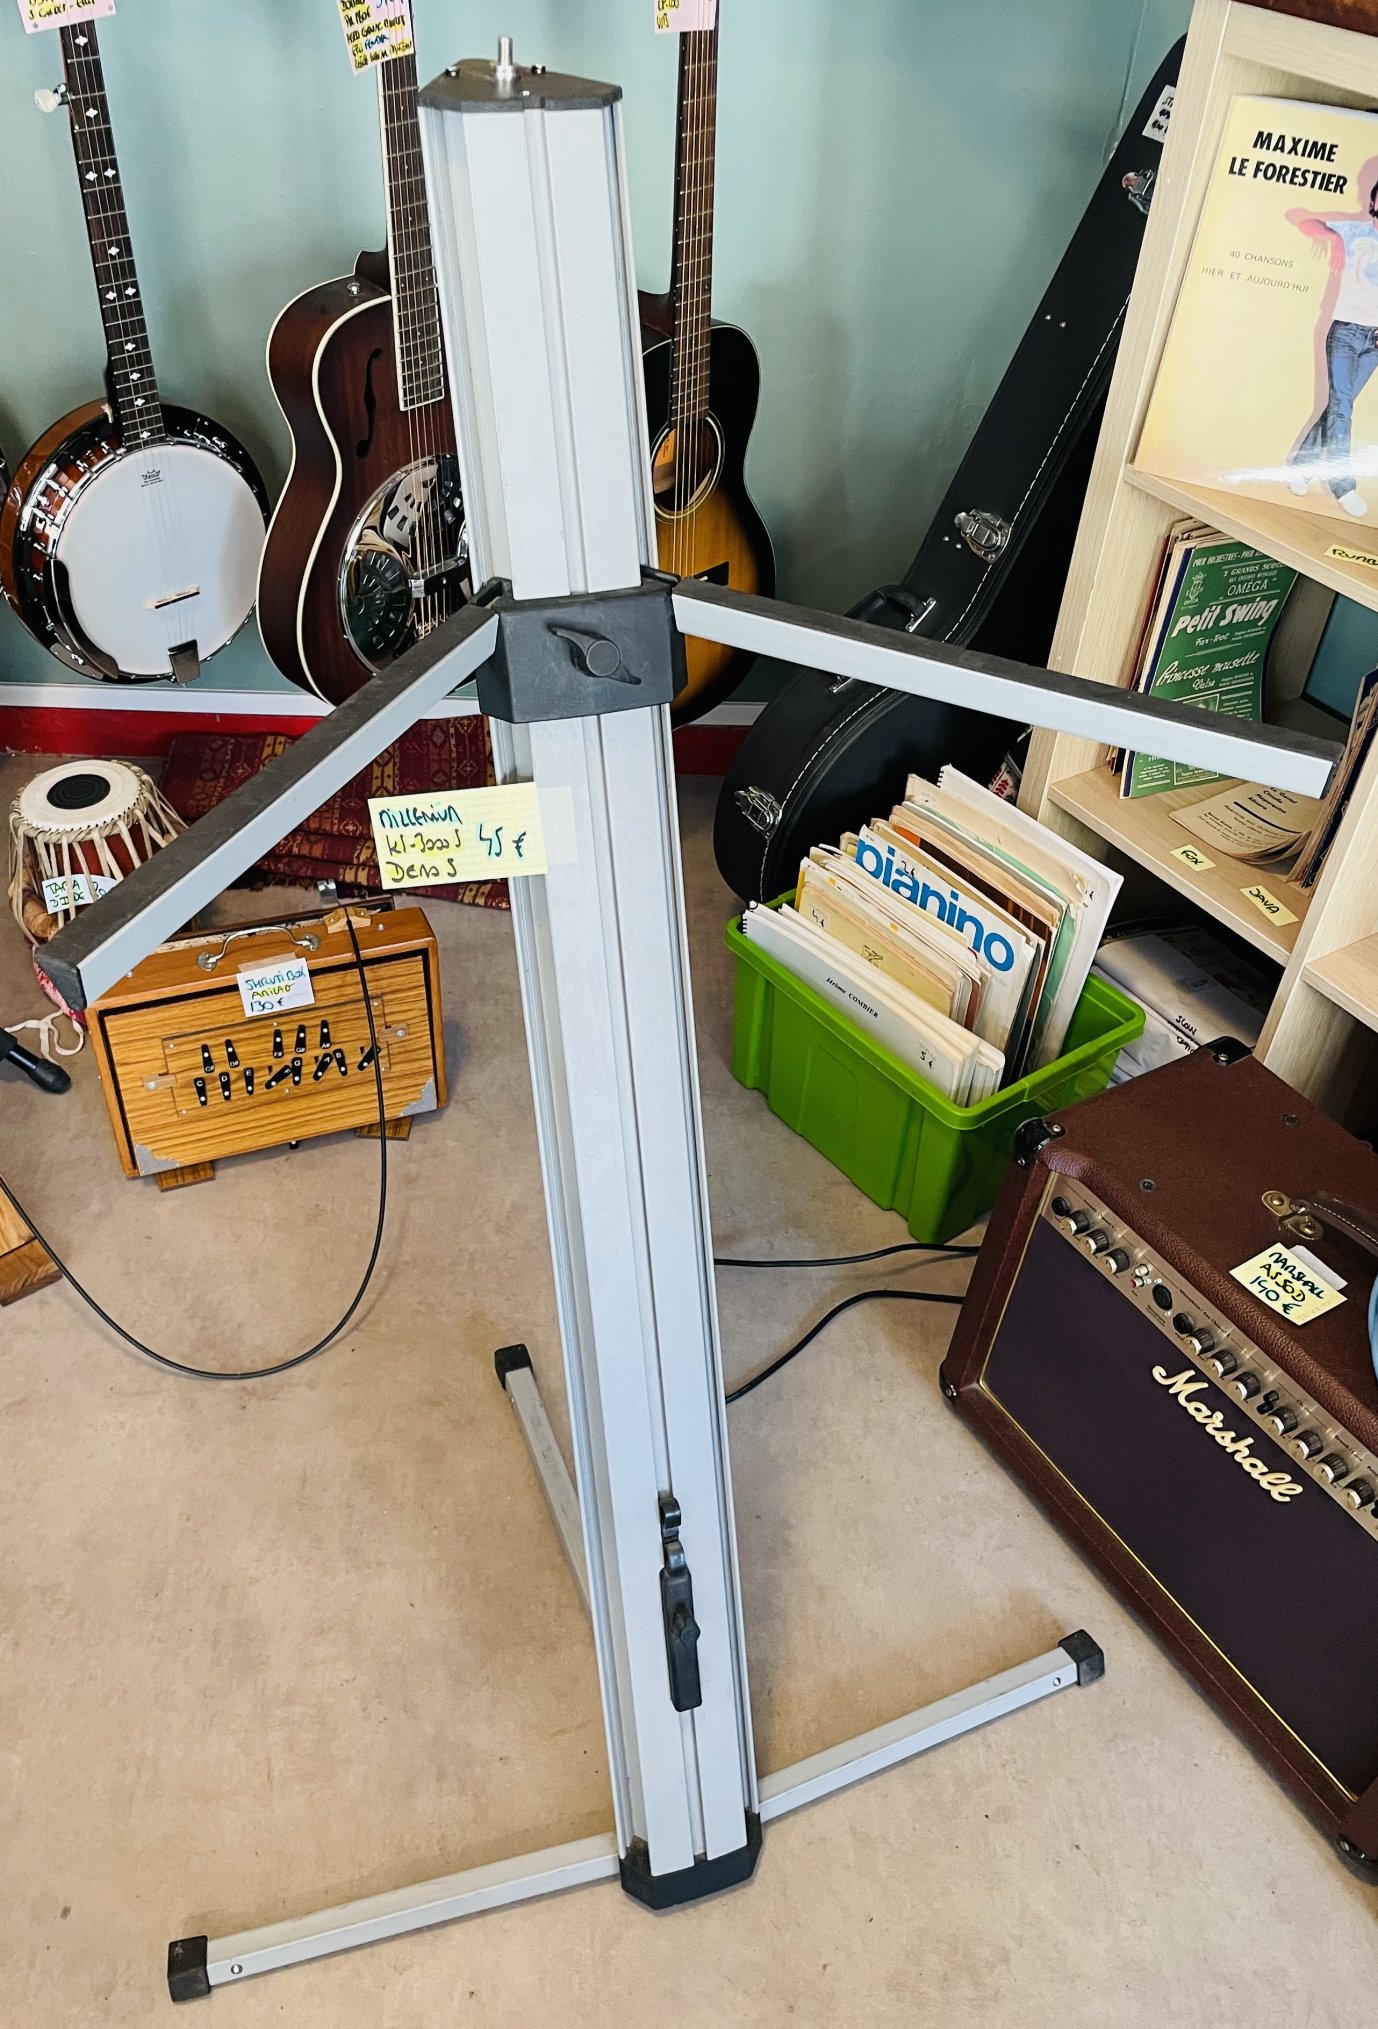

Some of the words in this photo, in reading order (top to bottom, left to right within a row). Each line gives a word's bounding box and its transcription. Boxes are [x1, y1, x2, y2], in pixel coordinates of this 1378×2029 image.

[1252, 130, 1339, 163] MAXIME
[1228, 156, 1250, 177] LE
[1252, 160, 1348, 195] FORESTIER
[1229, 250, 1241, 259] 40
[1244, 252, 1294, 269] CHANSONS
[1201, 266, 1224, 278] HIER
[1229, 271, 1243, 281] ET
[1246, 274, 1309, 293] AUJOURD'HUI
[1171, 603, 1222, 638] Petit
[1219, 597, 1280, 627] Swing
[1155, 659, 1210, 687] Princesse
[1211, 650, 1260, 673] musette
[479, 823, 504, 857] 45
[512, 830, 527, 858] €
[1181, 849, 1204, 865] FOX
[854, 837, 1015, 974] pianino
[1249, 887, 1281, 915] JAVA
[250, 1000, 275, 1013] 130
[848, 993, 880, 1019] COMBIER
[245, 1069, 252, 1077] E
[294, 1059, 301, 1067] G
[1249, 1275, 1281, 1302] 140
[1282, 1302, 1302, 1316] €
[1151, 1365, 1304, 1503] Marshall
